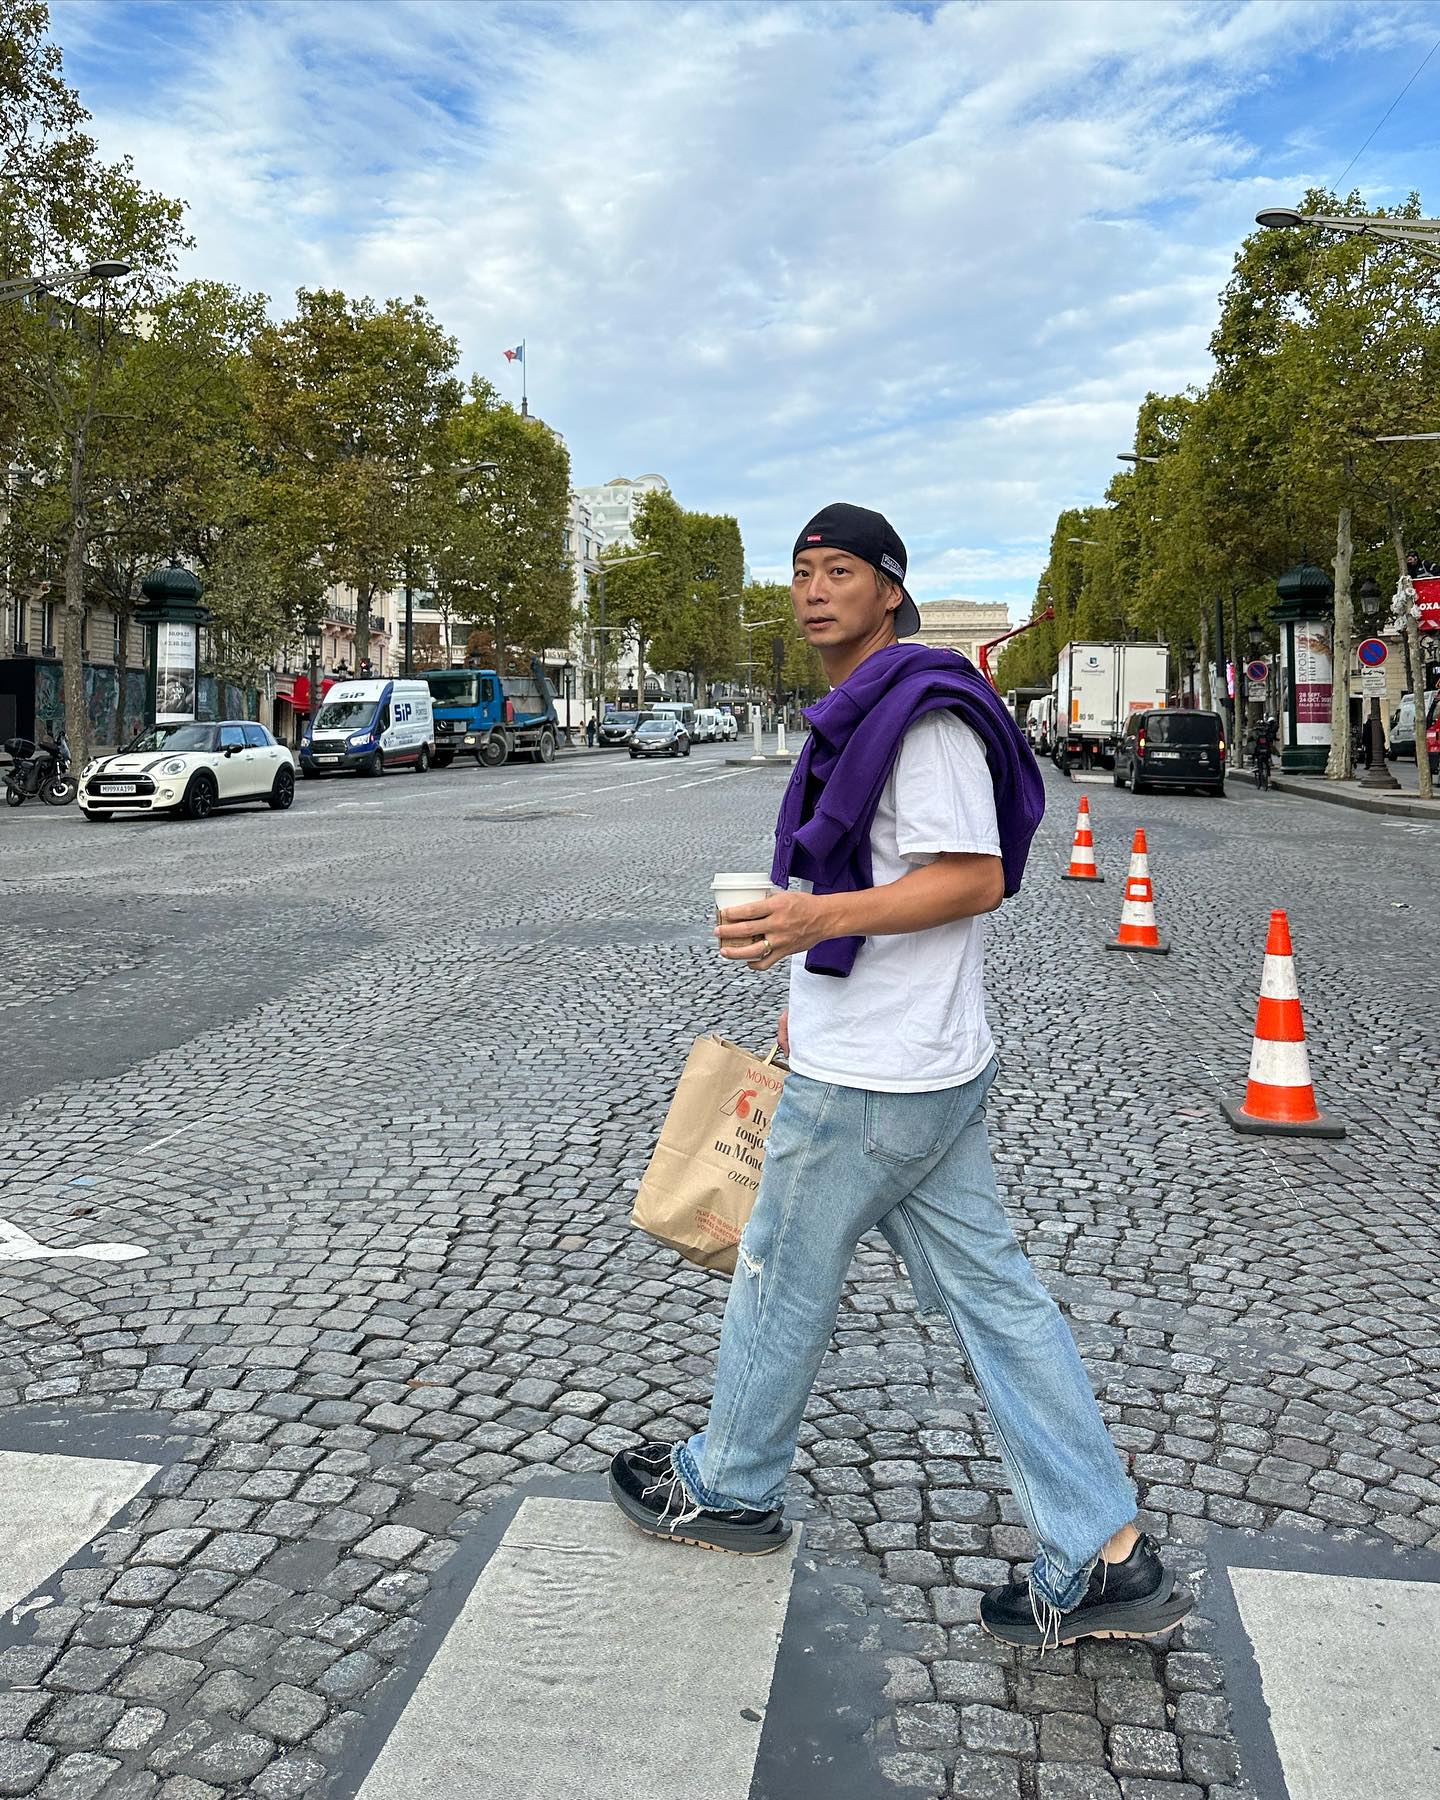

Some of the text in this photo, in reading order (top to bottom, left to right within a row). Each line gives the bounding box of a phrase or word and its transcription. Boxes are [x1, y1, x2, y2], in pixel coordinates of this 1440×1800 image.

[1419, 602, 1440, 610] OXA
[1297, 625, 1308, 682] EXPOSITION
[714, 1140, 731, 1156] un
